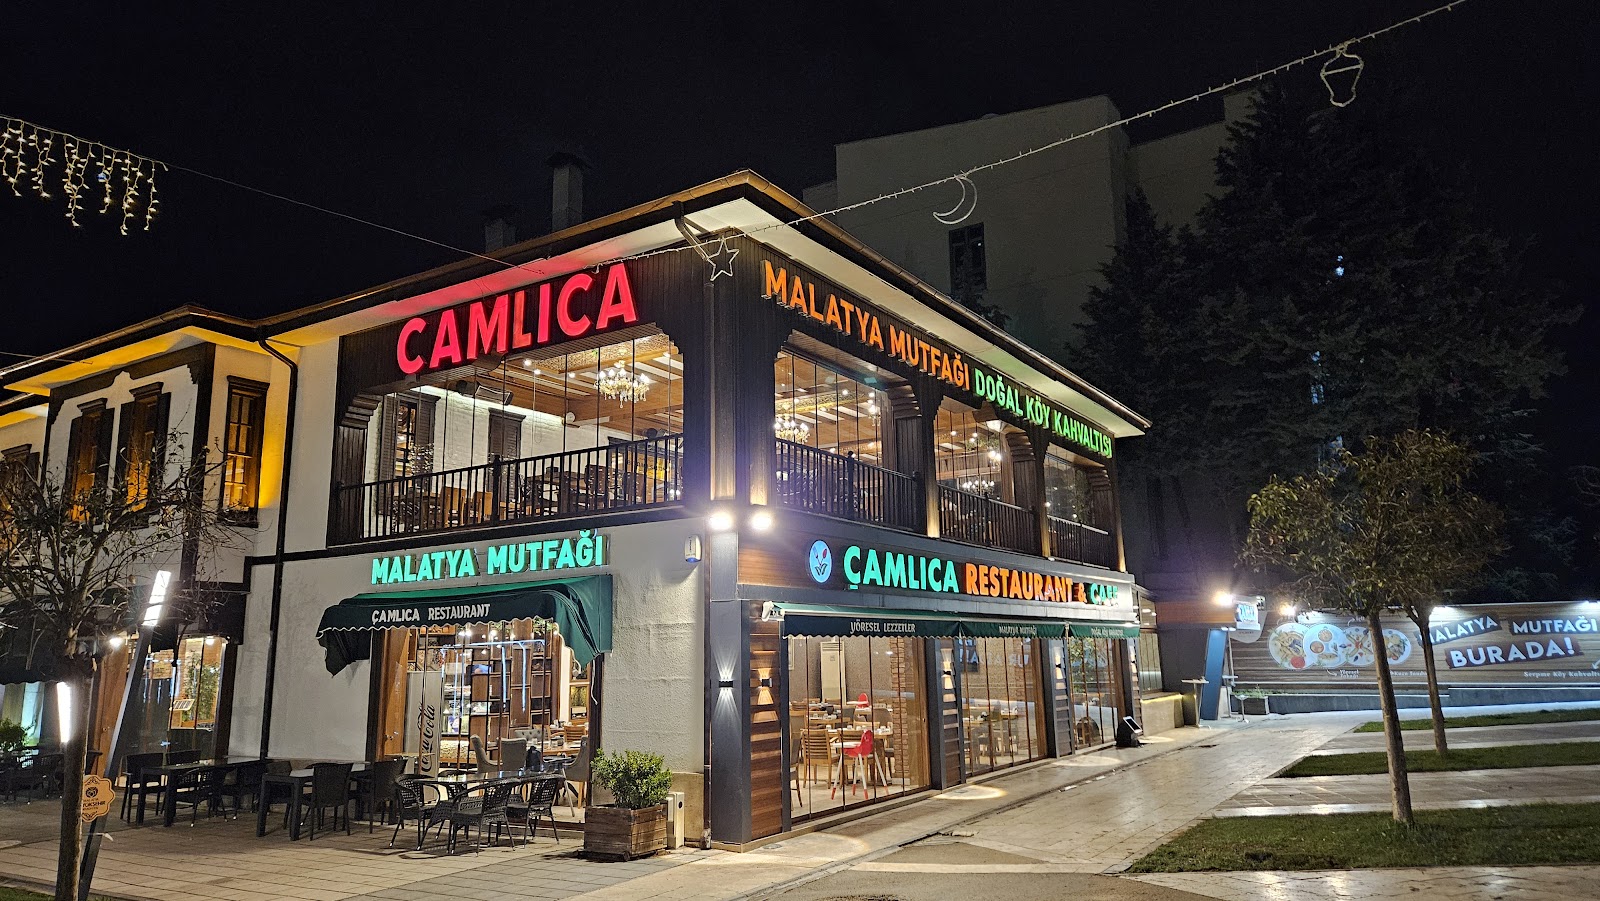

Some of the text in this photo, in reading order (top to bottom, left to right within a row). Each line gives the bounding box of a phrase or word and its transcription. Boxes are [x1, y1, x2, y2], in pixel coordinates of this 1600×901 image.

[761, 259, 970, 391] MALATYA MUTFAĞI
[974, 367, 1113, 459] DOĞAL KÖY KAHVALTISI
[371, 529, 607, 585] MALATYA MUTFAĞI
[843, 545, 959, 593] ÇAMLICA
[965, 562, 1073, 603] RESTAURANT
[1077, 582, 1088, 604] &
[371, 603, 491, 625] ÇAMLICA RESTAURANT
[850, 618, 916, 635] YÖRESEL LEZZETLER
[1512, 616, 1598, 634] MUTFAĞI
[1450, 636, 1576, 668] BURADA!
[1523, 671, 1551, 679] Serpme
[1553, 671, 1567, 679] Köy
